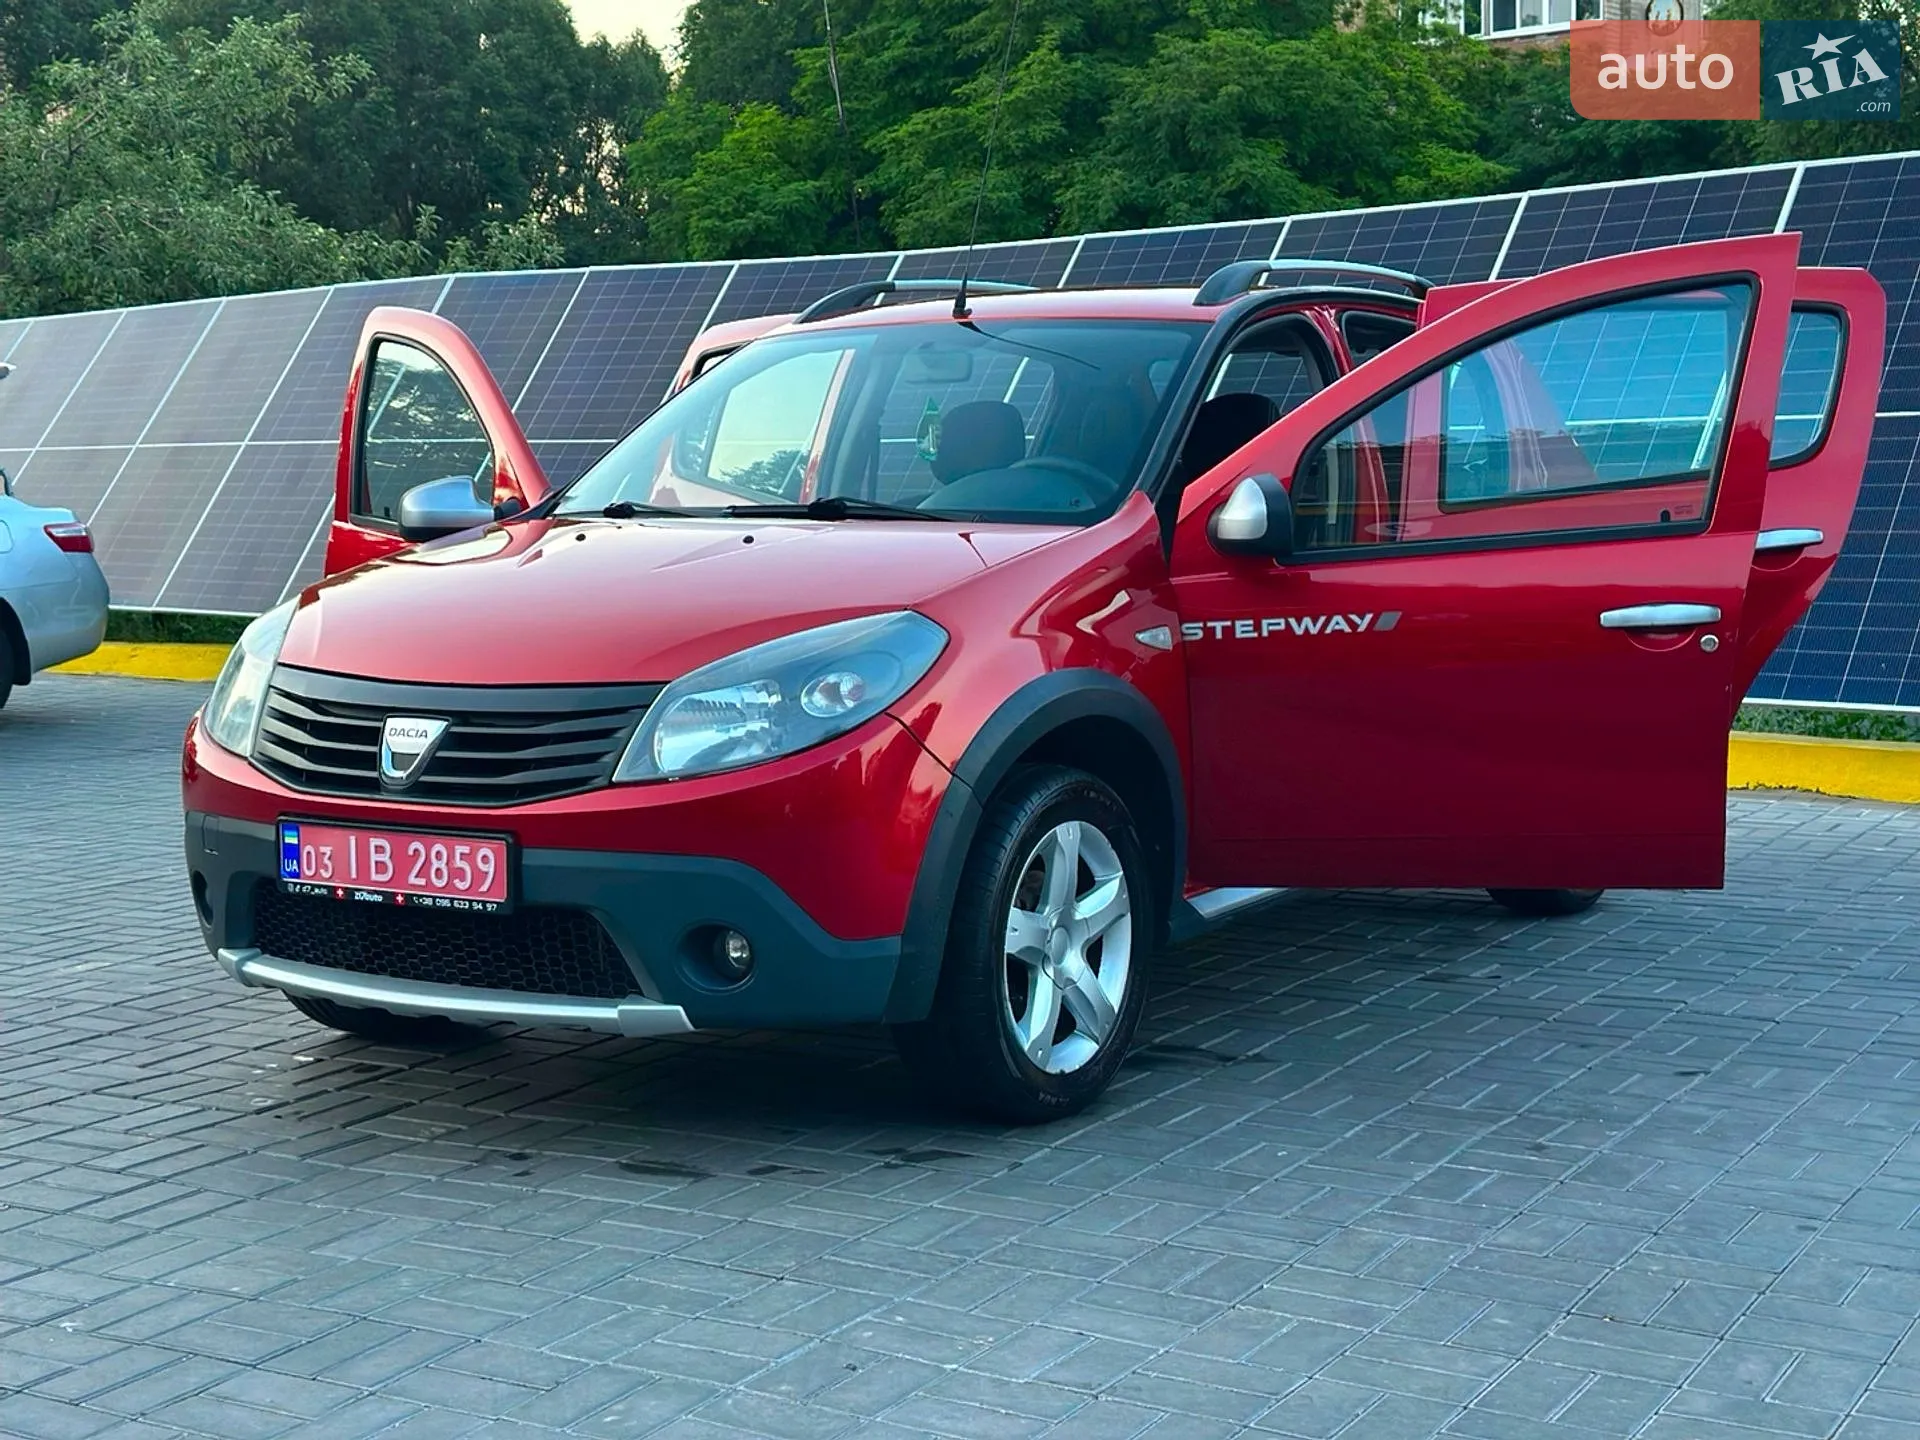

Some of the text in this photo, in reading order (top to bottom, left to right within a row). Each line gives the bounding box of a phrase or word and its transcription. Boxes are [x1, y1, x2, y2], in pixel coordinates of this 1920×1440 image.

[1181, 612, 1375, 641] STEPWAY
[388, 727, 429, 739] DACIA
[284, 859, 299, 873] UA
[302, 834, 496, 893] 03 IB 2859
